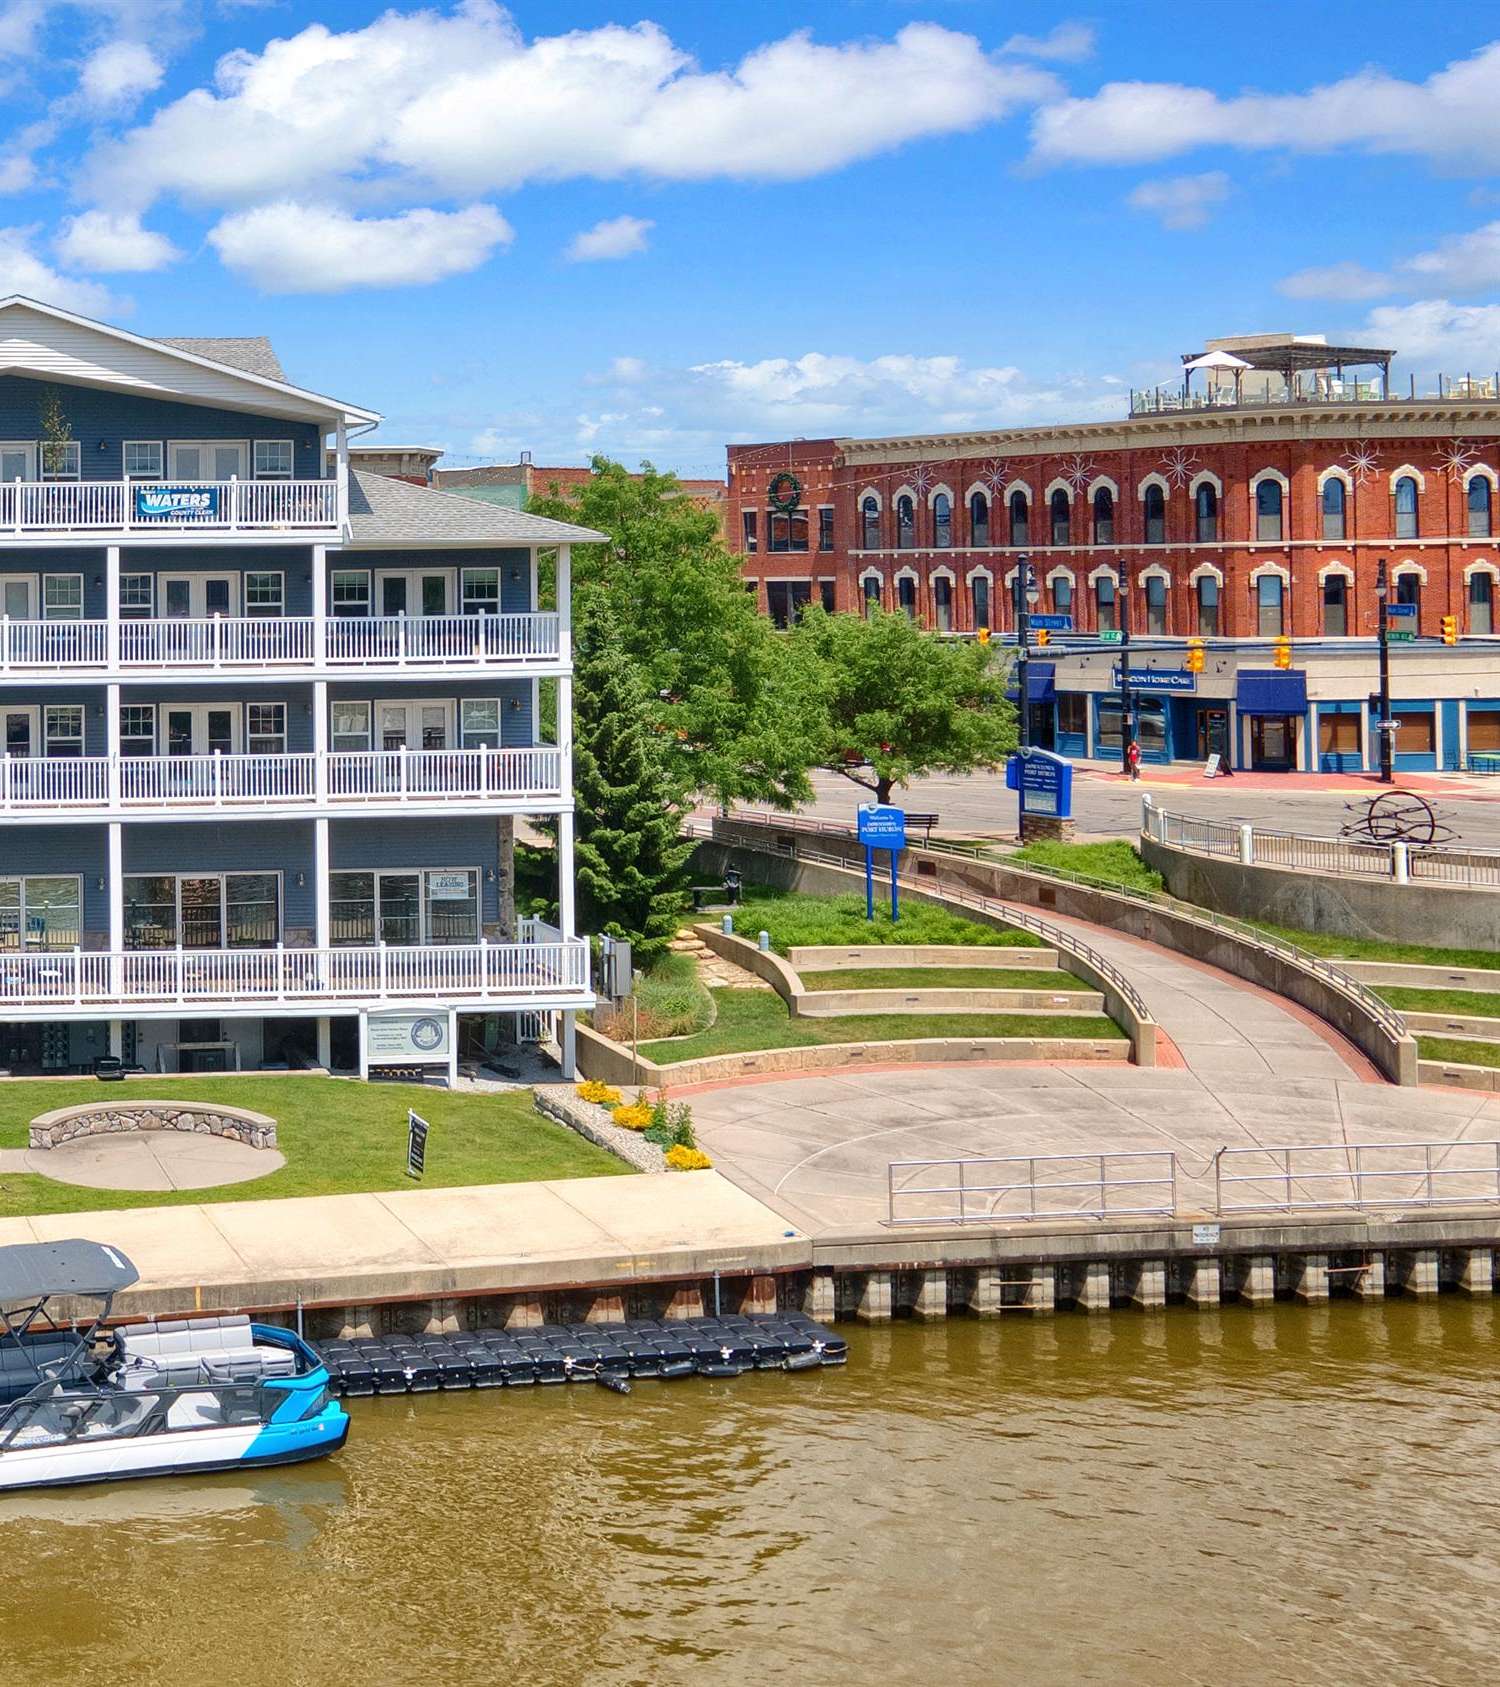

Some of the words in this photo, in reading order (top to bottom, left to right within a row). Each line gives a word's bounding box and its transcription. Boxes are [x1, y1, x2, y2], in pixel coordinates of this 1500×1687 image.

[146, 493, 210, 506] WATERS
[1031, 618, 1043, 626] Main
[1045, 619, 1062, 627] Street
